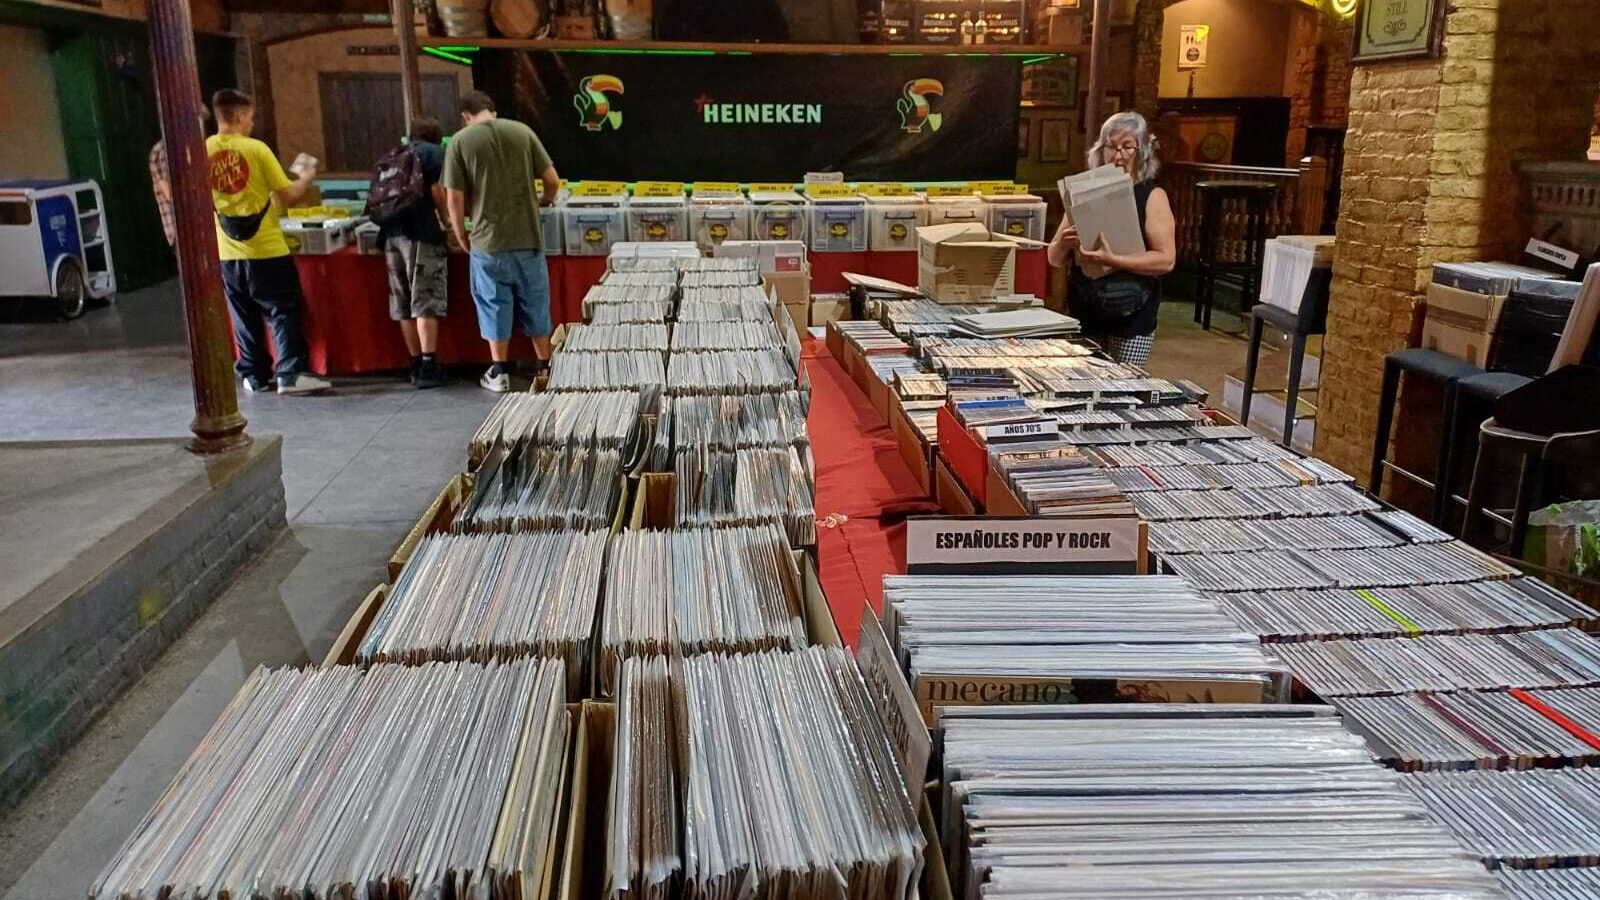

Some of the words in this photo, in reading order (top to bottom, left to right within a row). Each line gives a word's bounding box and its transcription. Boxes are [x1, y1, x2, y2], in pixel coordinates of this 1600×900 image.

[703, 104, 822, 123] HEINEKEN
[1004, 424, 1025, 434] AÑOS
[936, 530, 1019, 549] ESPAÑOLES
[1022, 533, 1053, 549] POP
[1056, 533, 1067, 548] Y
[1068, 533, 1112, 549] ROCK
[927, 680, 1062, 703] mecano
